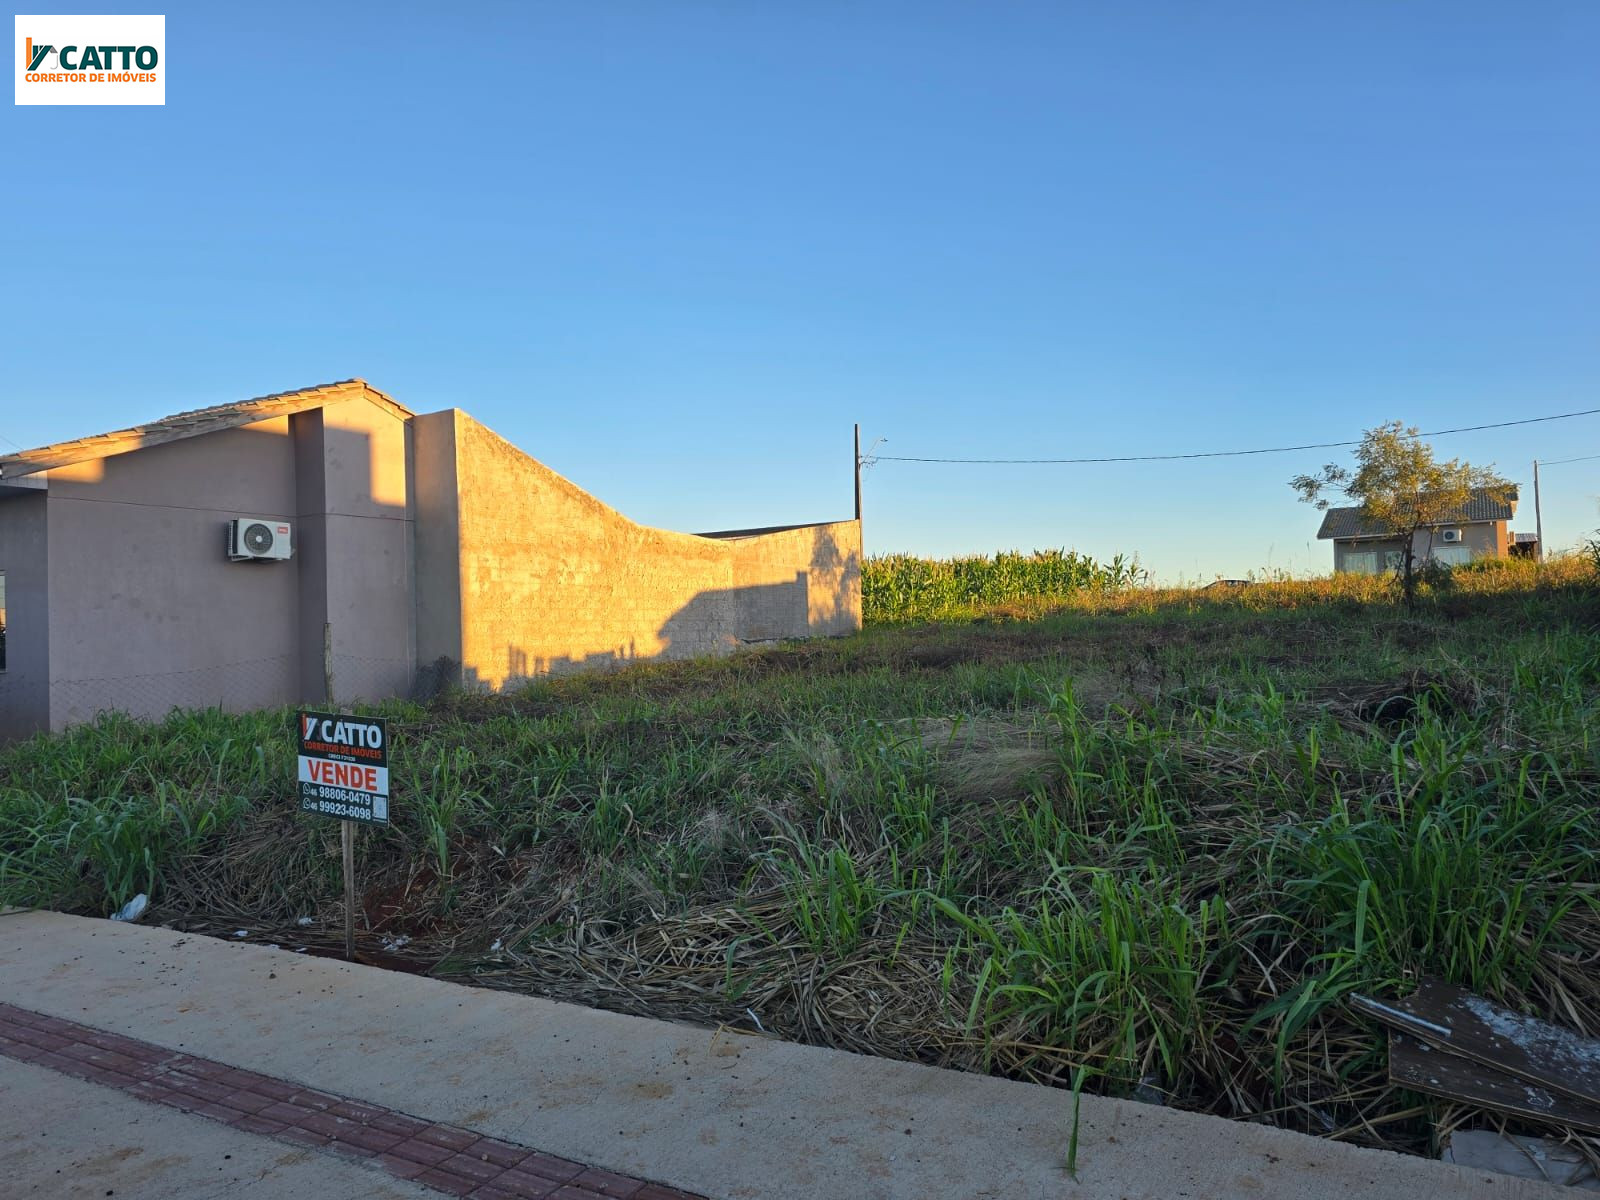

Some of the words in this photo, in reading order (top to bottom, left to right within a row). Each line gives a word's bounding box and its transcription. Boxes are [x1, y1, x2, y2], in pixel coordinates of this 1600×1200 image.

[321, 720, 382, 749] CATTO
[304, 741, 340, 754] CORRETOR
[341, 744, 351, 755] DE
[308, 759, 378, 792] VENDE
[319, 786, 371, 806] 98806-0479
[319, 800, 371, 820] 99923-6098
